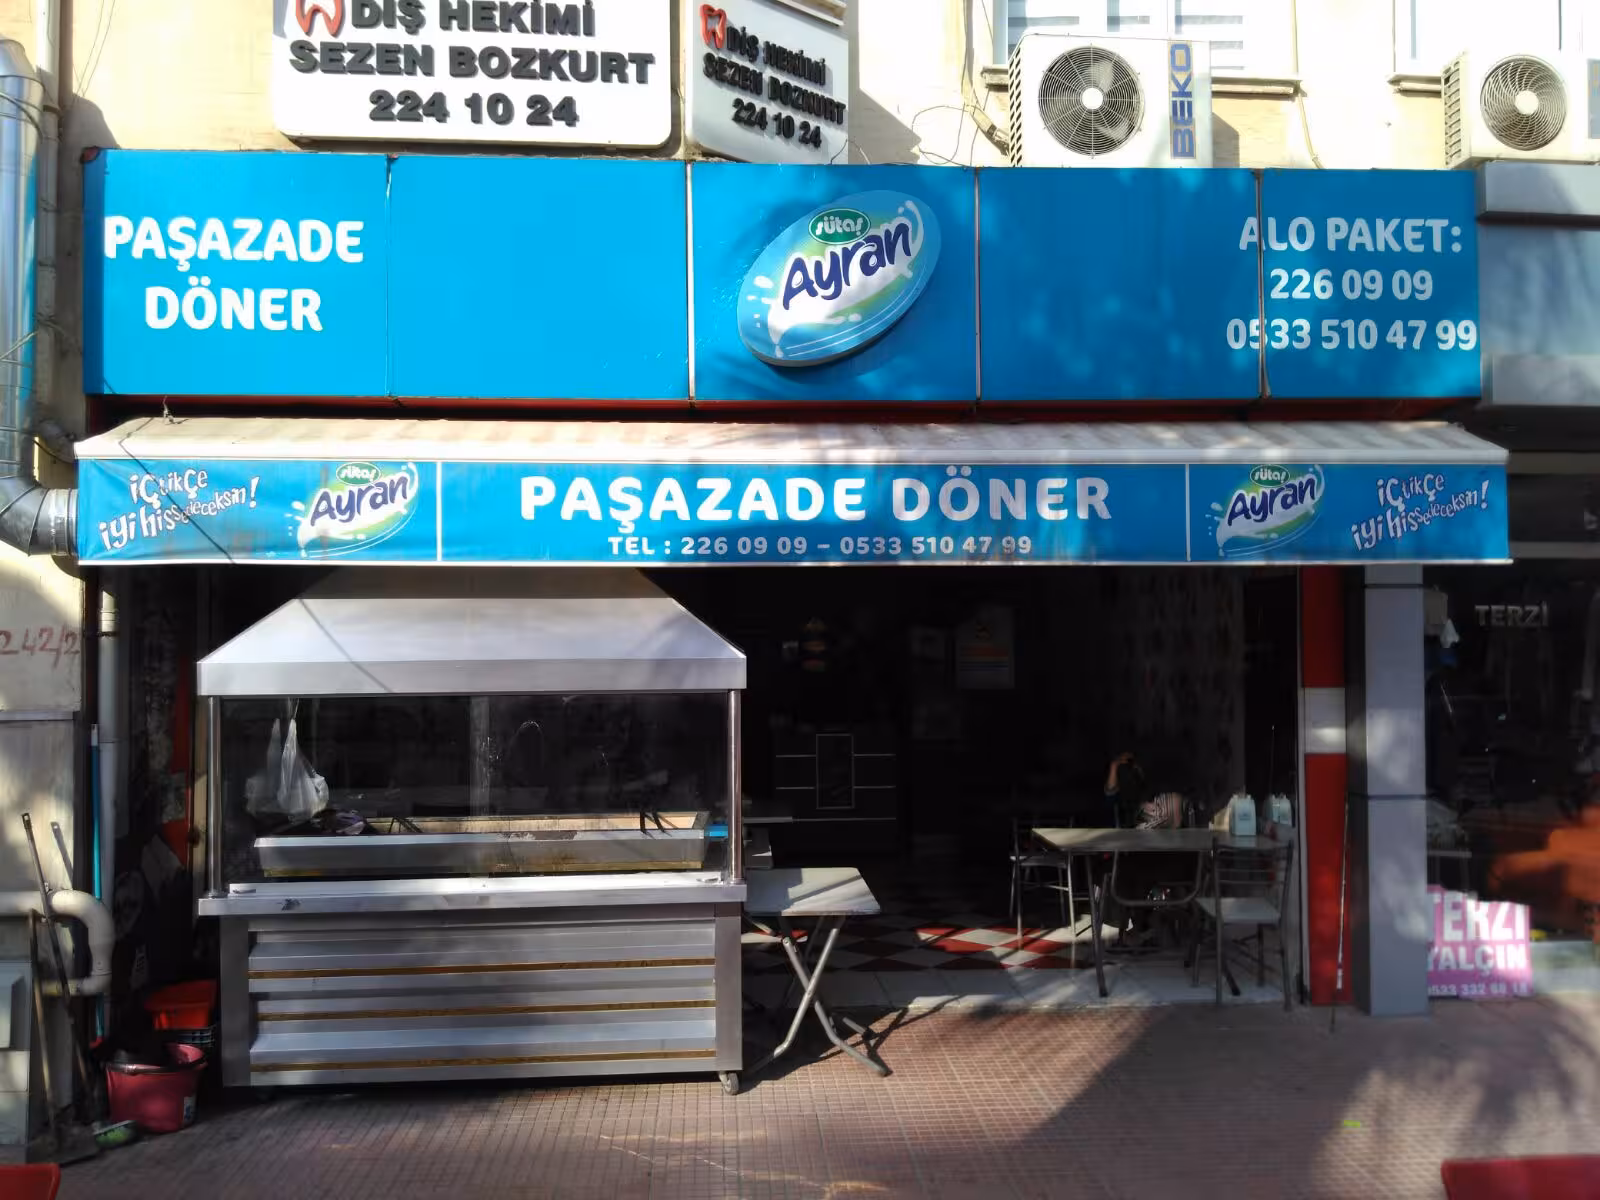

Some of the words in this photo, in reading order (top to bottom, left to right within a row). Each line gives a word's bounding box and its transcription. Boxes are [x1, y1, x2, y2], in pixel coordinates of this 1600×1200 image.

[289, 40, 435, 77] SEZEN
[449, 46, 655, 84] BOZKURT
[369, 89, 450, 123] 224
[464, 92, 515, 125] 10
[526, 94, 580, 127] 24
[703, 53, 763, 95] SEZEN
[768, 76, 846, 125] BOZKURT
[1170, 43, 1195, 158] BEKO
[732, 98, 768, 131] 224
[773, 112, 795, 138] 10
[799, 121, 822, 148] 24
[104, 215, 364, 272] PAŞAZADE
[1239, 216, 1315, 252] ALO
[1326, 217, 1462, 253] PAKET:
[783, 222, 912, 310] Ayran
[1269, 268, 1334, 300] 226
[1342, 269, 1384, 301] 09
[1391, 270, 1434, 301] 09
[145, 275, 323, 332] DÖNER
[1226, 319, 1312, 350] 0533
[1320, 320, 1378, 350] 510
[1386, 320, 1428, 350] 47
[1435, 319, 1478, 351] 99
[310, 476, 409, 527] Ayran
[520, 475, 867, 534] PAŞAZADE
[891, 465, 1113, 521] DÖNER
[1227, 477, 1316, 527] Ayran
[608, 536, 655, 555] TEL
[681, 536, 728, 555] 226
[737, 536, 768, 555] 09
[777, 536, 808, 555] 09
[840, 536, 901, 555] 0533
[911, 536, 954, 555] 510
[962, 536, 993, 554] 47
[1002, 536, 1032, 554] 99
